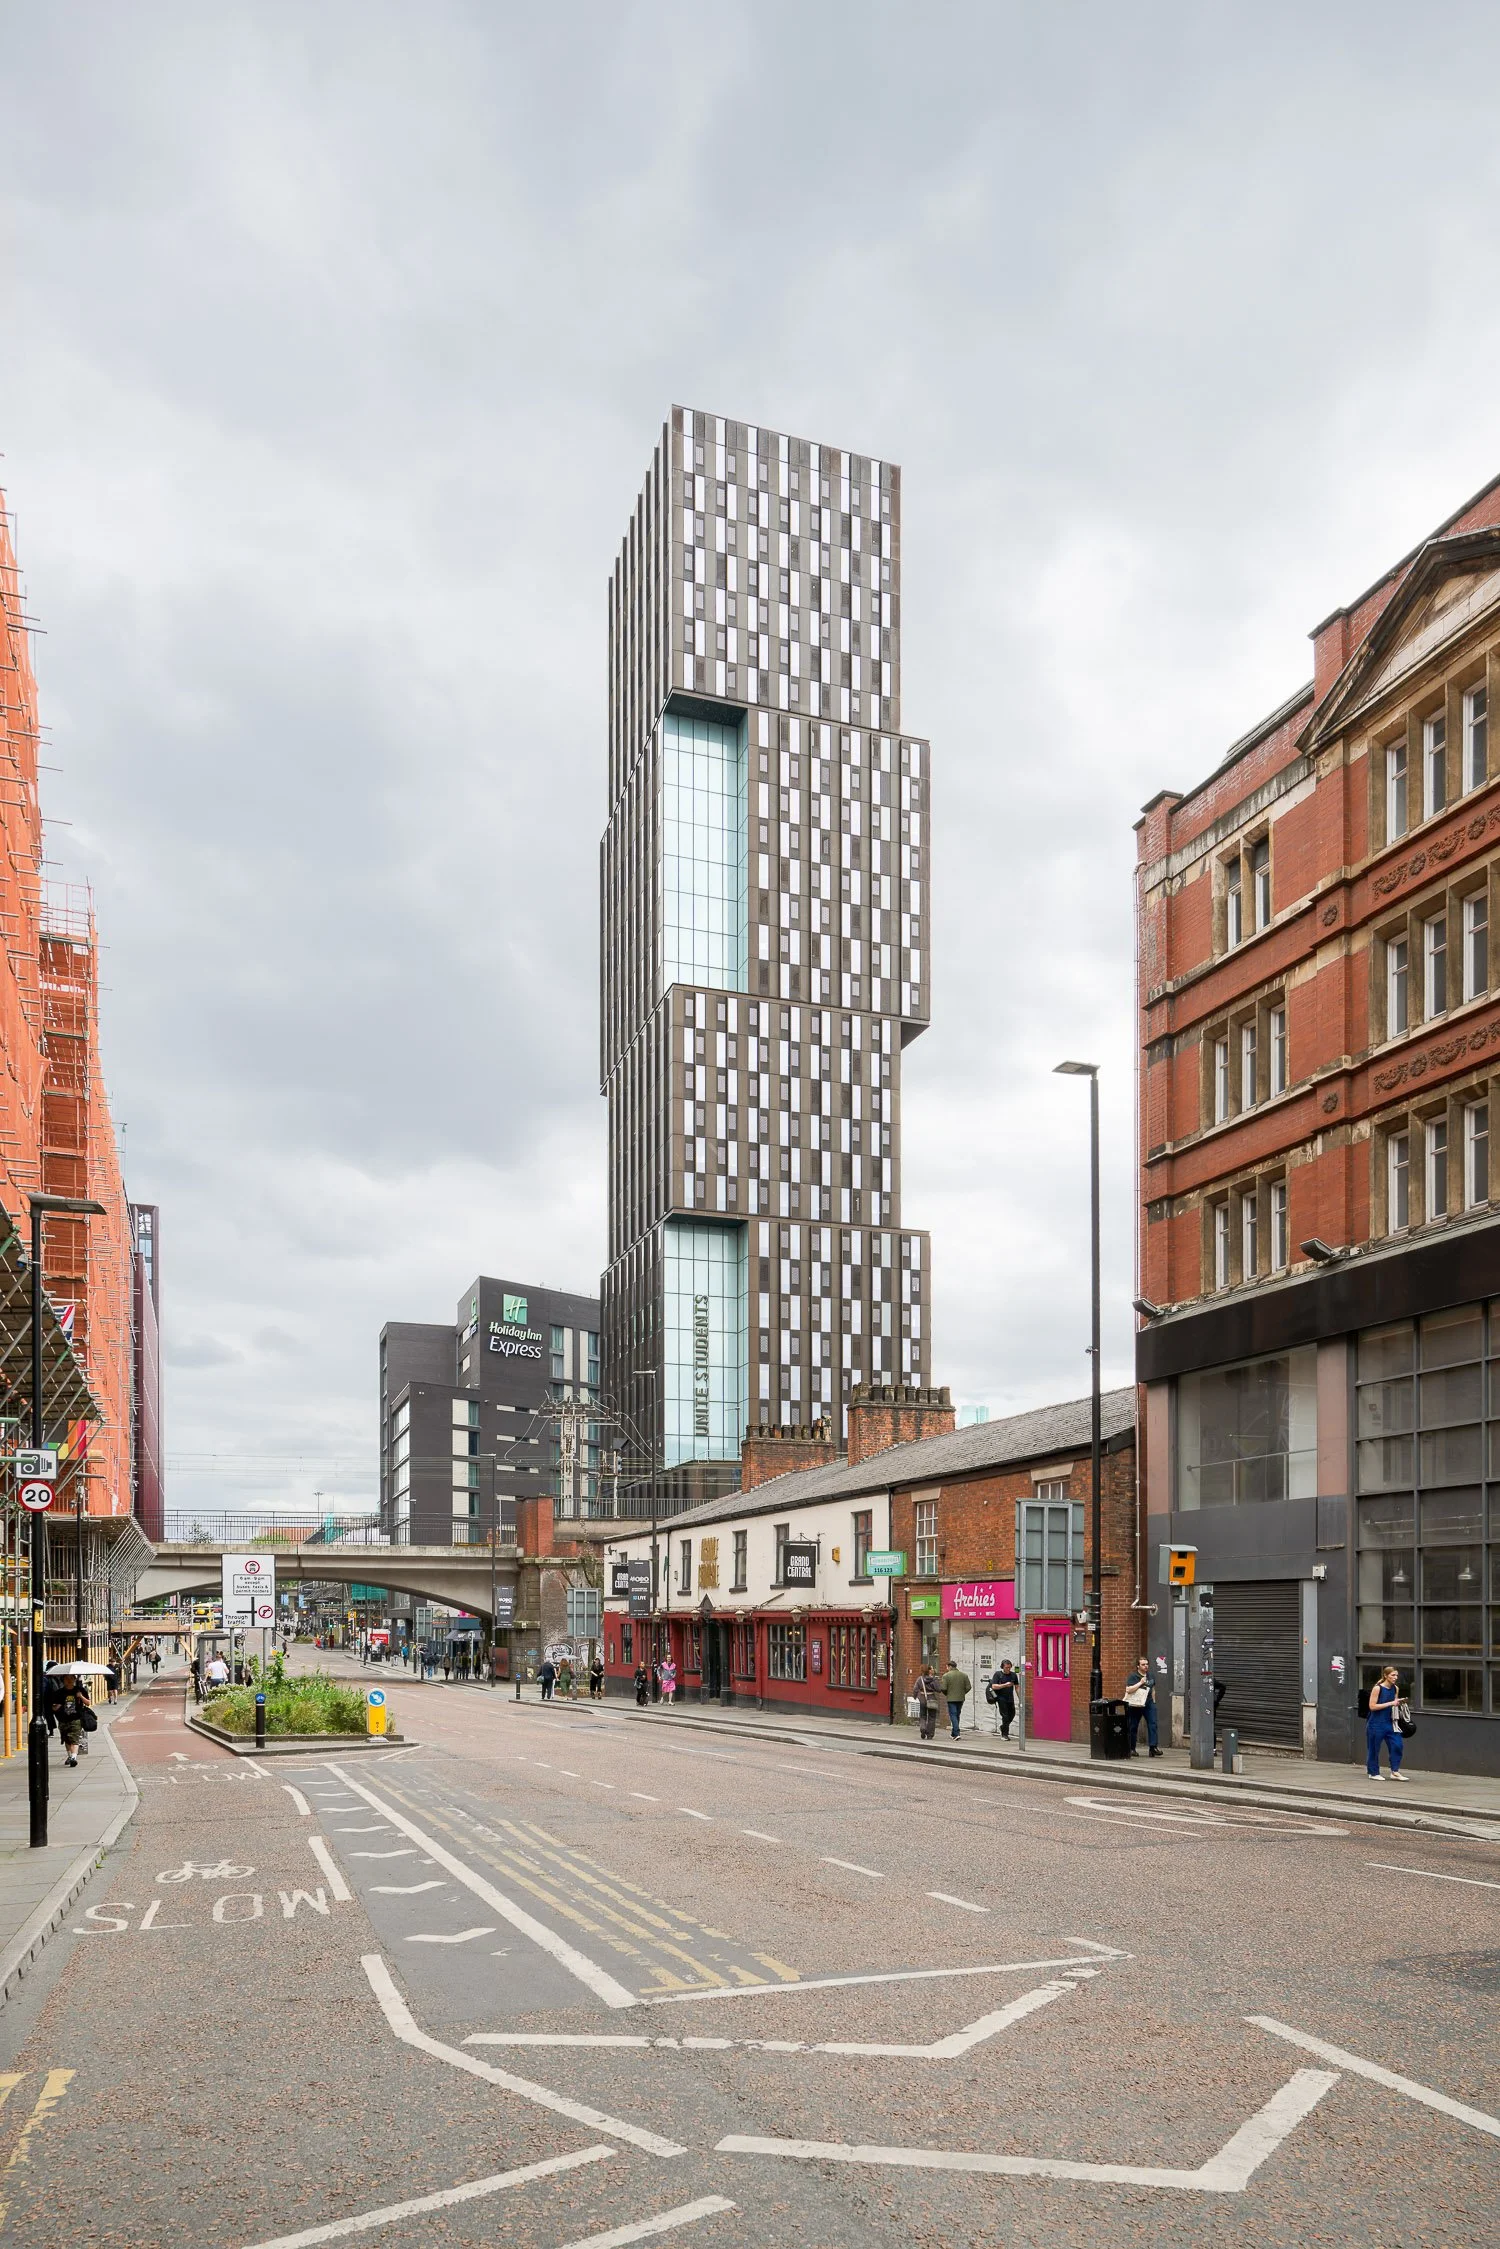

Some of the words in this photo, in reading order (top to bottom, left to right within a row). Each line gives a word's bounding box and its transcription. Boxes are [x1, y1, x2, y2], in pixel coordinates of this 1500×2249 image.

[489, 1321, 526, 1341] Holiday
[527, 1328, 542, 1341] Inn
[695, 1294, 709, 1382] STUDENTS
[489, 1335, 542, 1359] Express
[695, 1387, 710, 1438] UNITE
[25, 1489, 50, 1503] 20
[787, 1566, 812, 1578] CENTRAL
[790, 1555, 810, 1567] GRAND
[953, 1585, 996, 1611] Archie's
[136, 1771, 264, 1786] SLOW
[72, 1887, 331, 1935] SLOW
